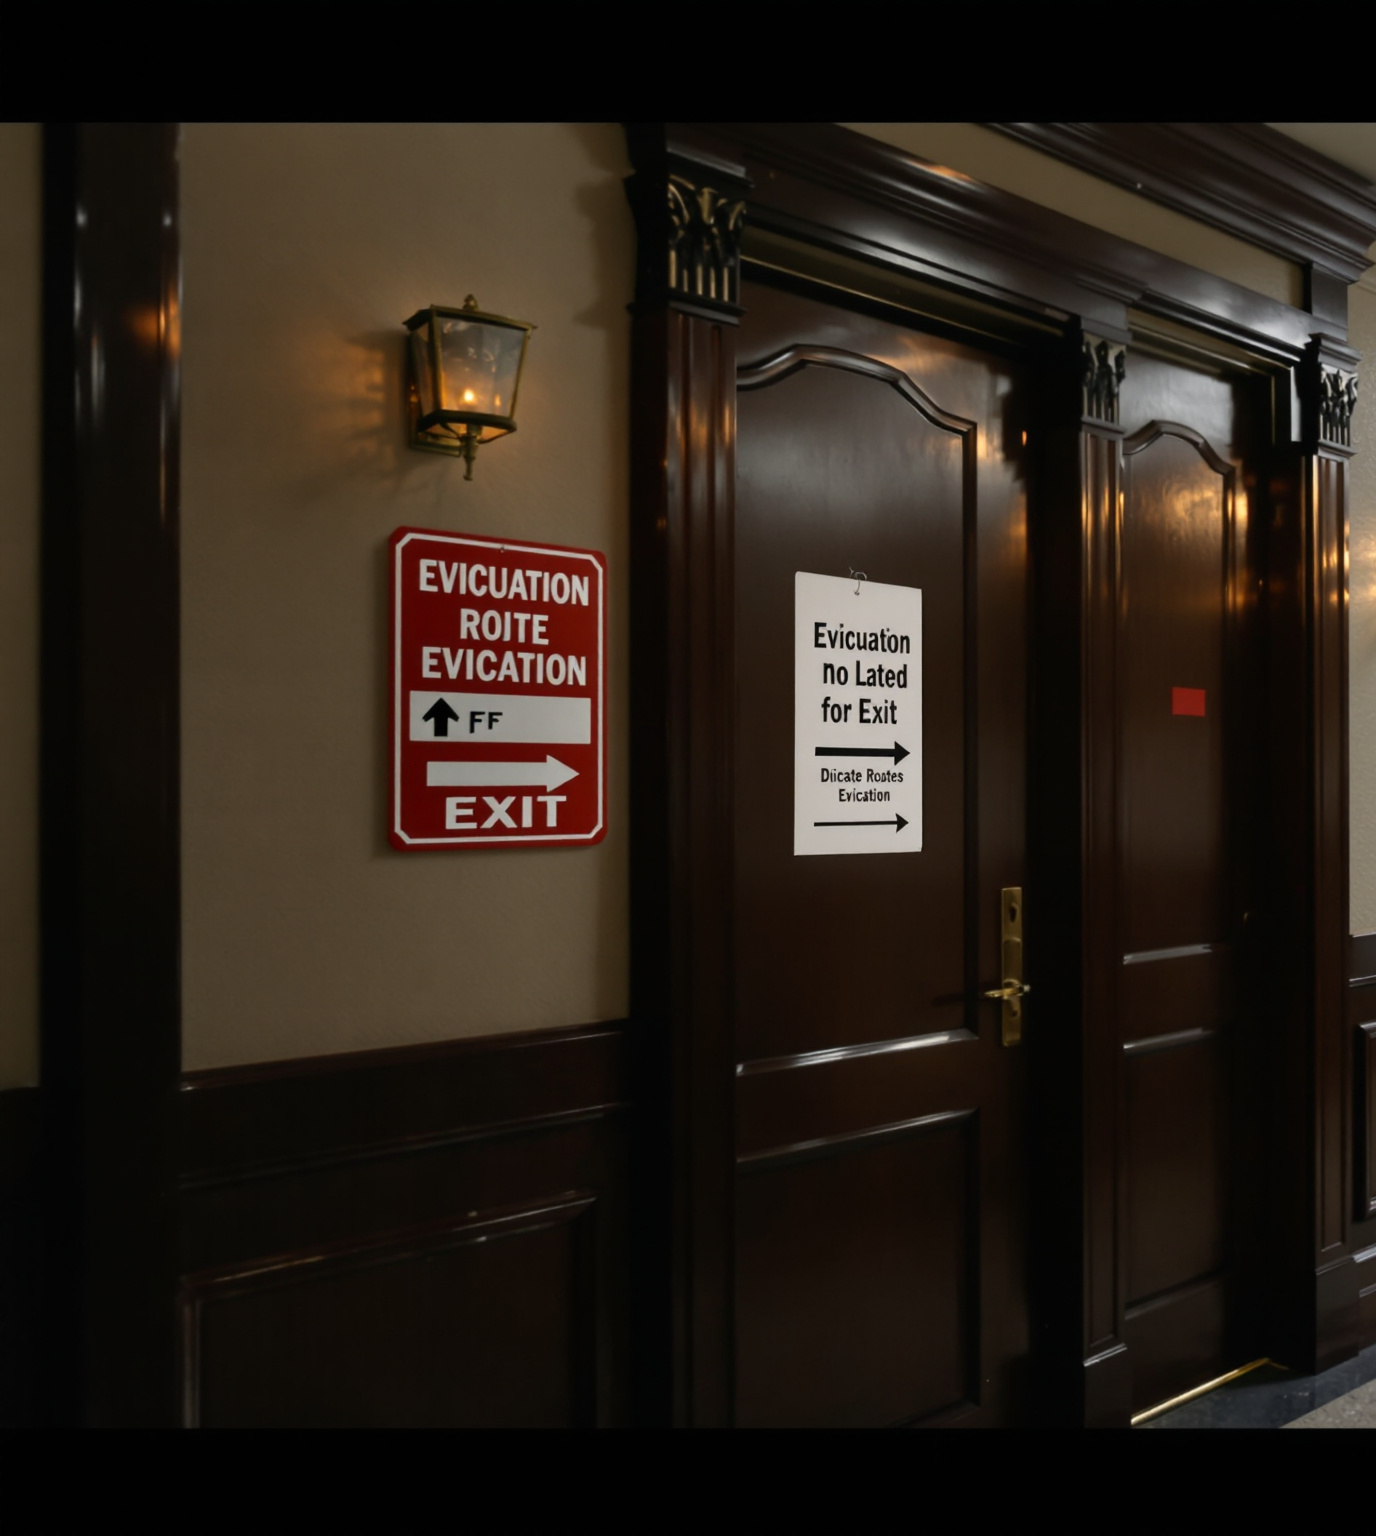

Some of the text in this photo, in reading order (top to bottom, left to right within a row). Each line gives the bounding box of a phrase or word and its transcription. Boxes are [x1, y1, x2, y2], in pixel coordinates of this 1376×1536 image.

[418, 557, 589, 606] EVICUATION
[459, 607, 549, 646] ROITE
[421, 646, 587, 686] EVICATION
[822, 660, 908, 689] no Lated
[468, 710, 503, 734] FF
[821, 696, 898, 725] for Exit
[445, 795, 567, 830] EXIT
